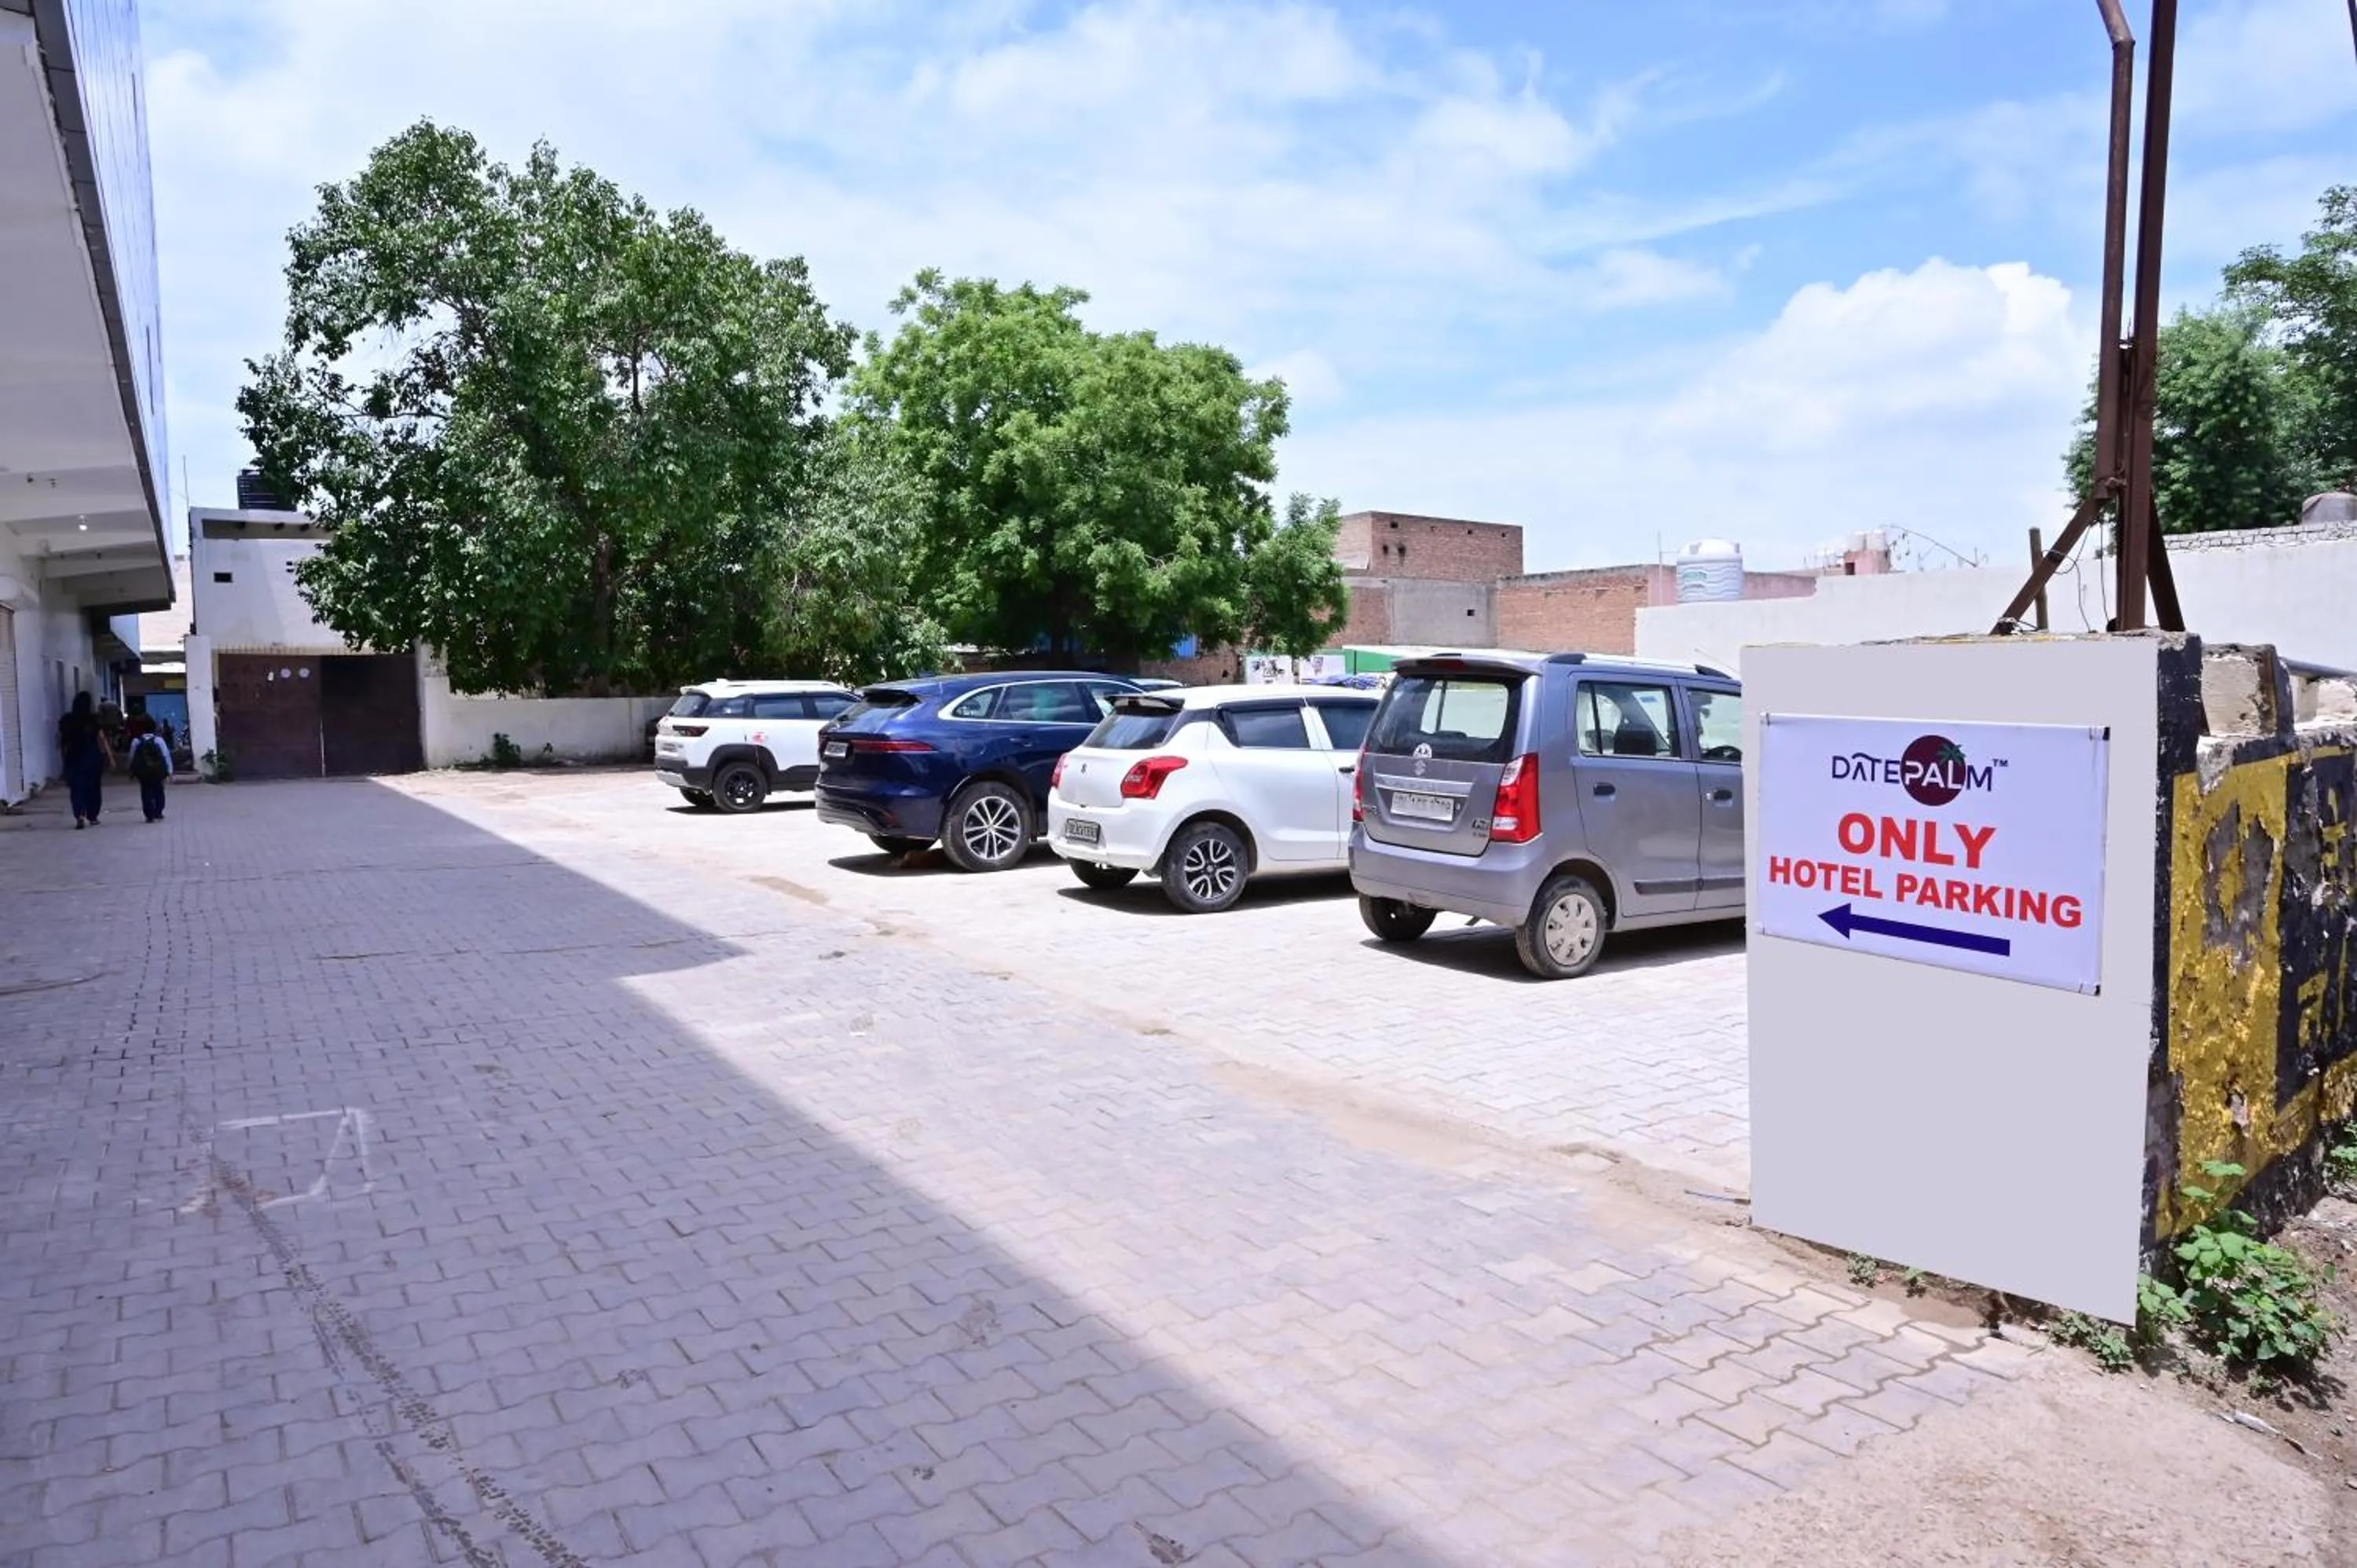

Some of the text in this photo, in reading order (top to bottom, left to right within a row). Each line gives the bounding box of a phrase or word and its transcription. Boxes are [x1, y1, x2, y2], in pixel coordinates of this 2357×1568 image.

[1838, 812, 1996, 869] ONLY
[1769, 855, 2082, 929] HOTEL PARKING
